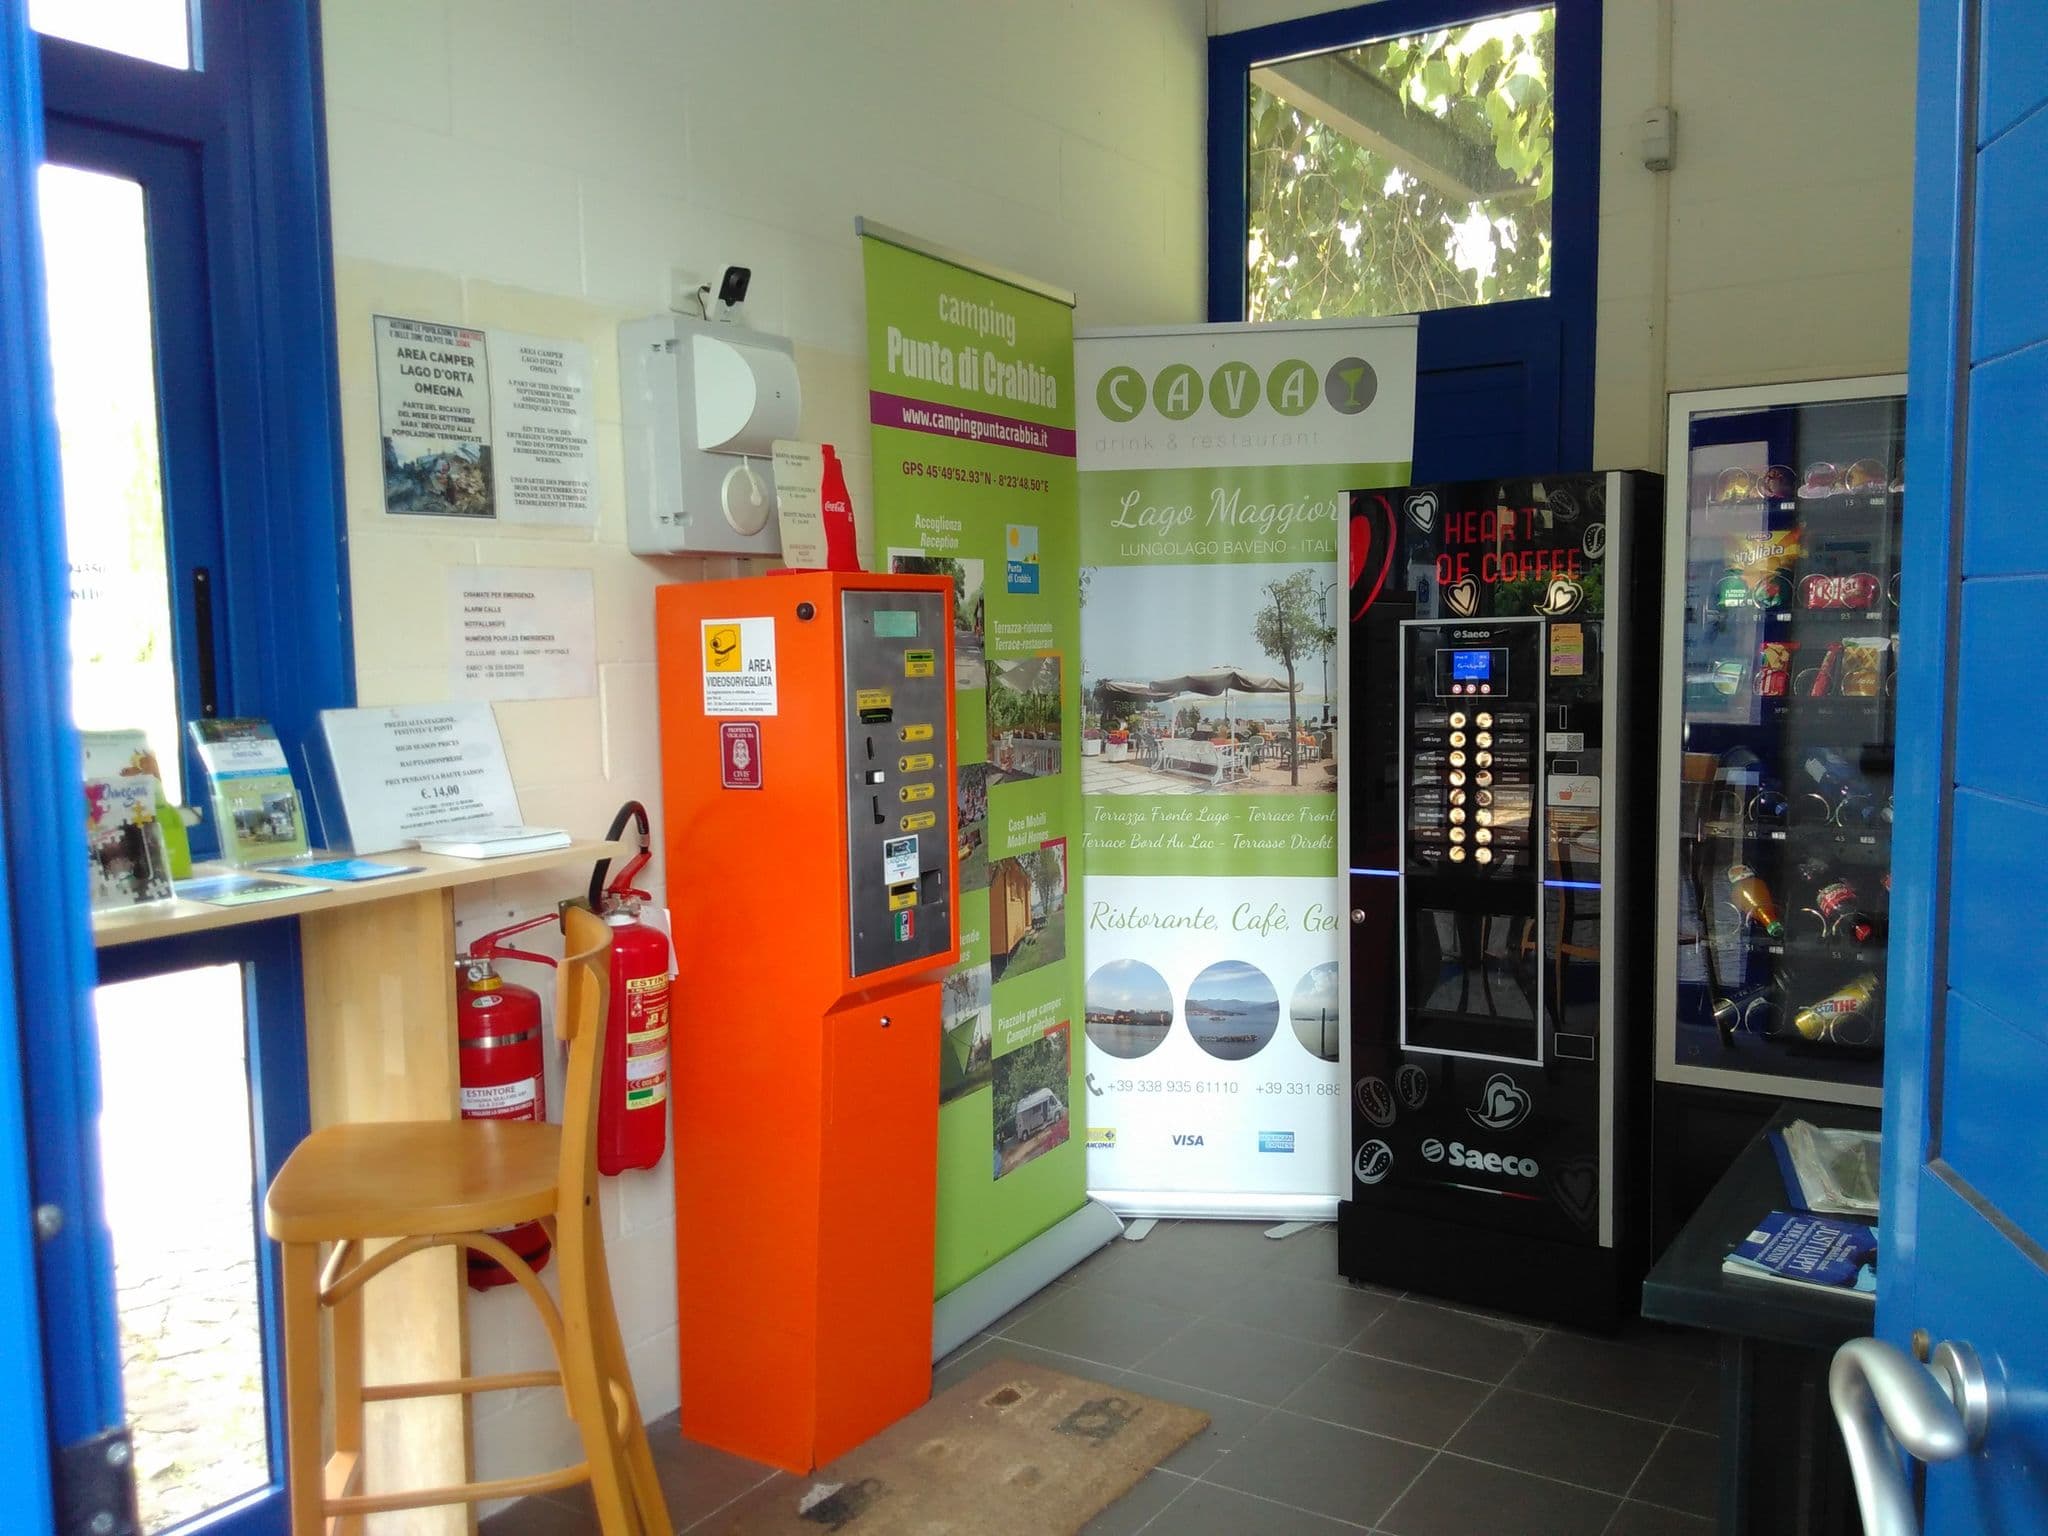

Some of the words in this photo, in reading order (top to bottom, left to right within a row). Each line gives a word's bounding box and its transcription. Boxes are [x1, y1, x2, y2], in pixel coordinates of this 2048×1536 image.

[939, 293, 1016, 348] camping
[397, 347, 427, 361] AREA
[429, 352, 475, 368] CAMPER
[400, 363, 431, 377] LAGO
[434, 368, 474, 384] D'ORTA
[887, 325, 954, 386] Punta
[958, 346, 980, 391] di
[983, 351, 1057, 409] Crabbia
[414, 382, 463, 398] OMEGNA
[1104, 364, 1311, 417] CAVA
[902, 407, 1049, 449] www.campingpuntacrabbia.it
[1095, 435, 1153, 453] drink
[1167, 433, 1178, 449] &
[1192, 431, 1321, 448] restaurant
[902, 461, 924, 477] GPS
[1110, 489, 1197, 537] Lago
[1205, 487, 1339, 535] Maggior
[915, 514, 962, 532] Accoglienza
[1445, 508, 1537, 545] HEART
[920, 533, 959, 550] Reception
[1120, 542, 1218, 557] LUNGOLAGO
[1223, 540, 1287, 554] BAVENO
[1302, 539, 1337, 553] ITALI
[1436, 552, 1470, 586] OF
[1482, 549, 1583, 583] COFFEE
[1461, 630, 1490, 638] Saeco
[748, 658, 772, 672] AREA
[706, 676, 773, 687] VIDEOSORVEGLIATA
[433, 784, 460, 798] 14,00
[1094, 806, 1145, 826] Terrazza
[1151, 806, 1193, 822] Fronte
[1197, 806, 1230, 825] Lago
[1248, 806, 1295, 822] Terrace
[1299, 806, 1337, 822] Front
[1081, 832, 1126, 849] Terrace
[1130, 832, 1165, 849] Bord
[1166, 833, 1186, 849] Au
[1189, 832, 1215, 849] Lac
[1232, 832, 1285, 849] Terrasse
[1290, 833, 1334, 849] Direkt
[1090, 901, 1219, 932] Ristorante,
[1232, 902, 1289, 938] Cafè,
[1303, 903, 1338, 932] Gel
[631, 977, 664, 988] ESTIN
[466, 1086, 515, 1097] ESTINTORE
[1107, 1080, 1134, 1093] +39
[1137, 1080, 1162, 1093] 338
[1167, 1080, 1192, 1093] 935
[1196, 1080, 1239, 1094] 61110
[1255, 1082, 1282, 1095] +39
[1286, 1082, 1311, 1095] 331
[1316, 1083, 1340, 1096] 888
[1172, 1134, 1204, 1146] VISA
[1449, 1142, 1539, 1178] Saeco
